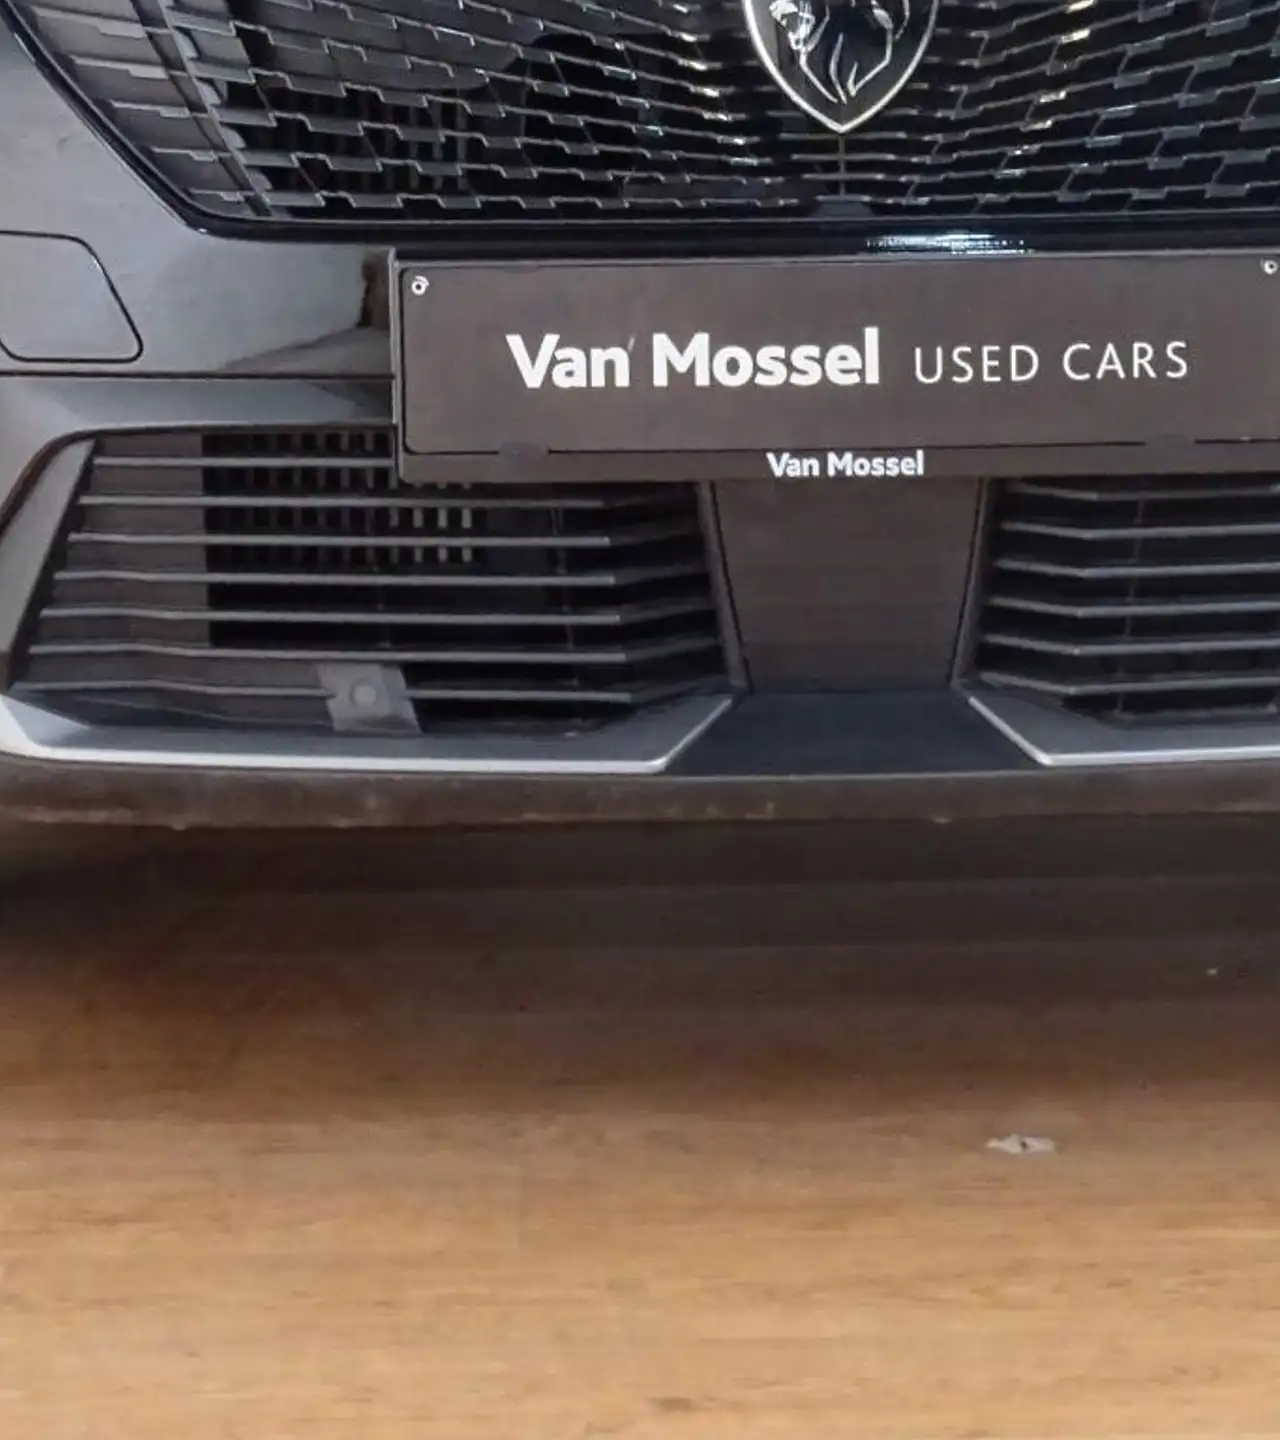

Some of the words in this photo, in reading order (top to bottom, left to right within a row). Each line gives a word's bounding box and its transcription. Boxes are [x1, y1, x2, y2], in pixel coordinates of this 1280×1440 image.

[506, 333, 630, 389] Van
[653, 327, 880, 388] Mossel
[914, 345, 1039, 384] USED
[1062, 341, 1188, 381] CARS
[766, 451, 820, 478] Van
[827, 449, 925, 477] Mossel
